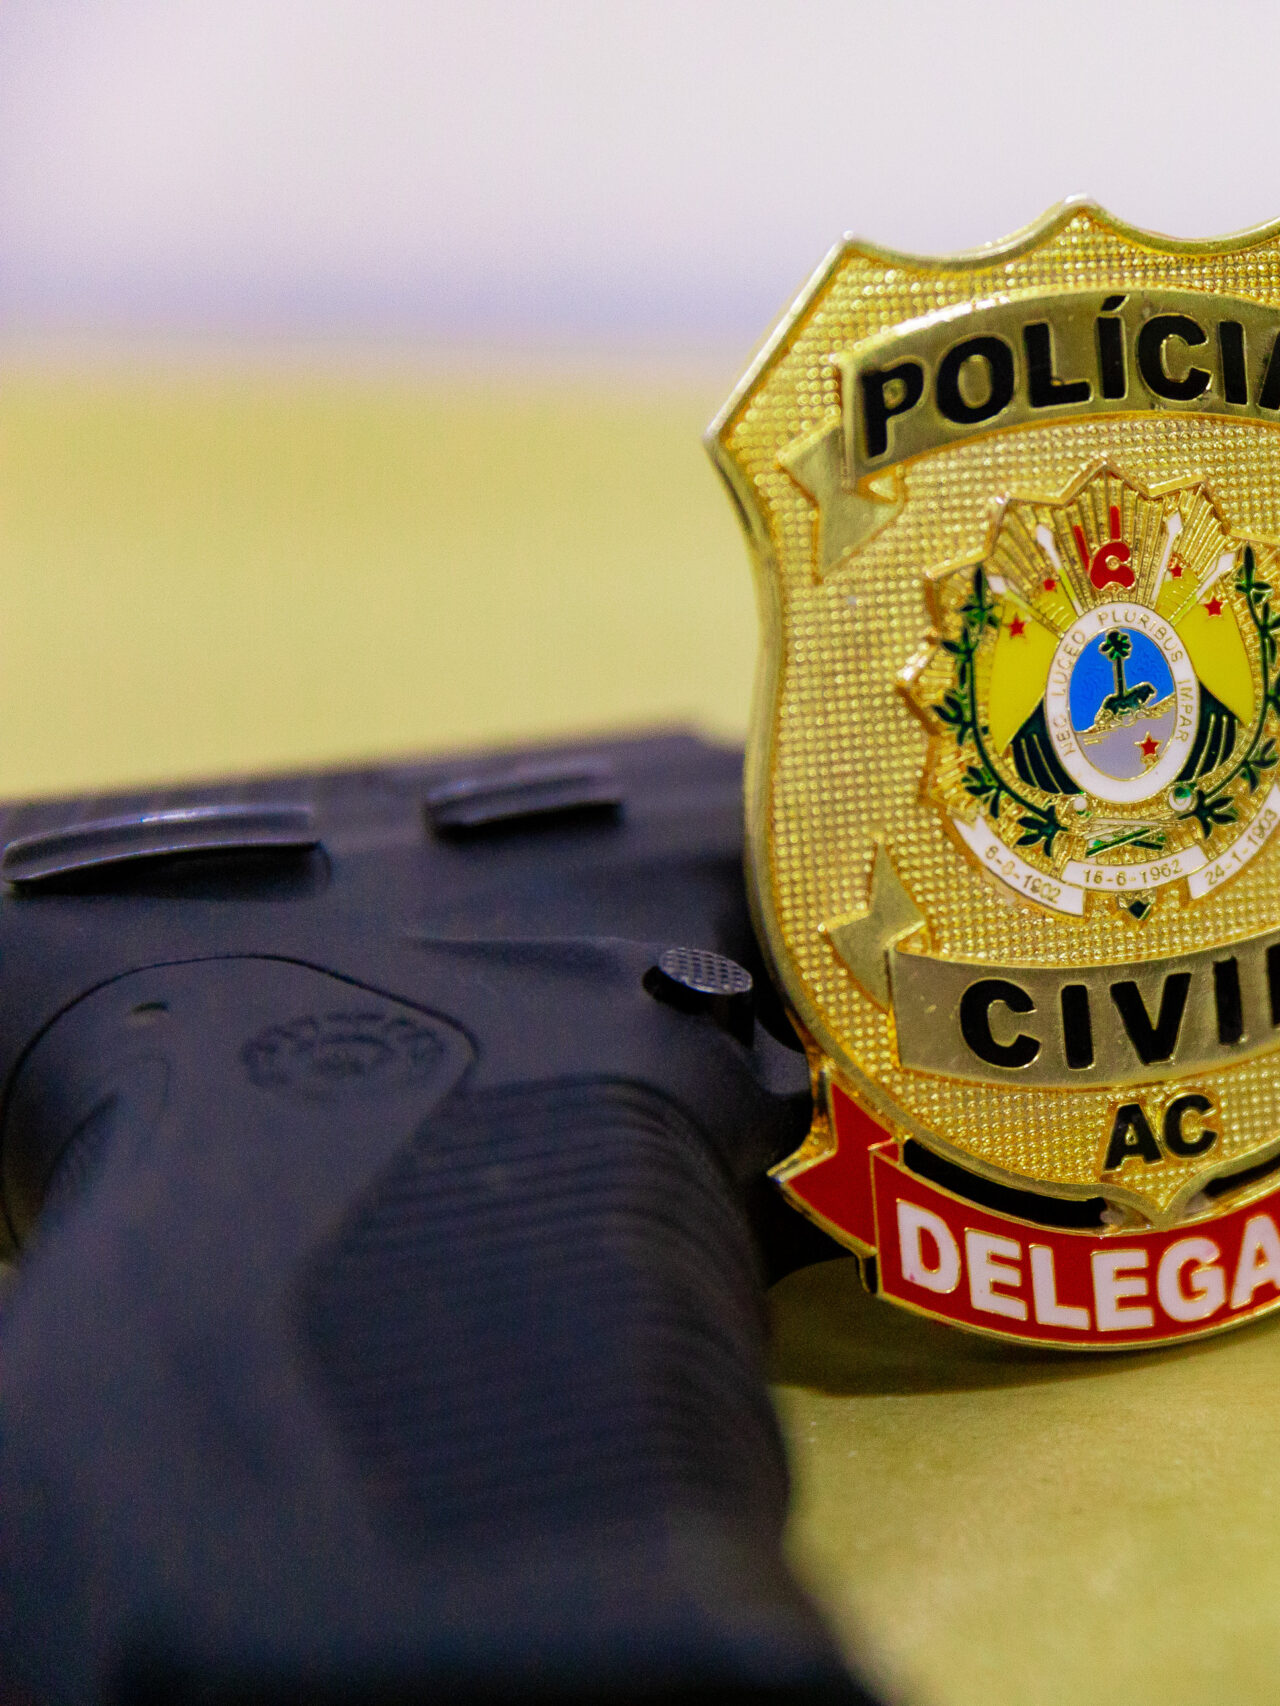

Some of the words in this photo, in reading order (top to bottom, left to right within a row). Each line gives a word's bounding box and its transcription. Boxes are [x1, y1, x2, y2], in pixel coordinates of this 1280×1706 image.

[1051, 631, 1086, 697] LUCEO
[1097, 610, 1184, 663] PLURIBUS
[1053, 714, 1076, 756] NEC
[1175, 679, 1193, 743] IMPAR
[1104, 1094, 1219, 1171] AC
